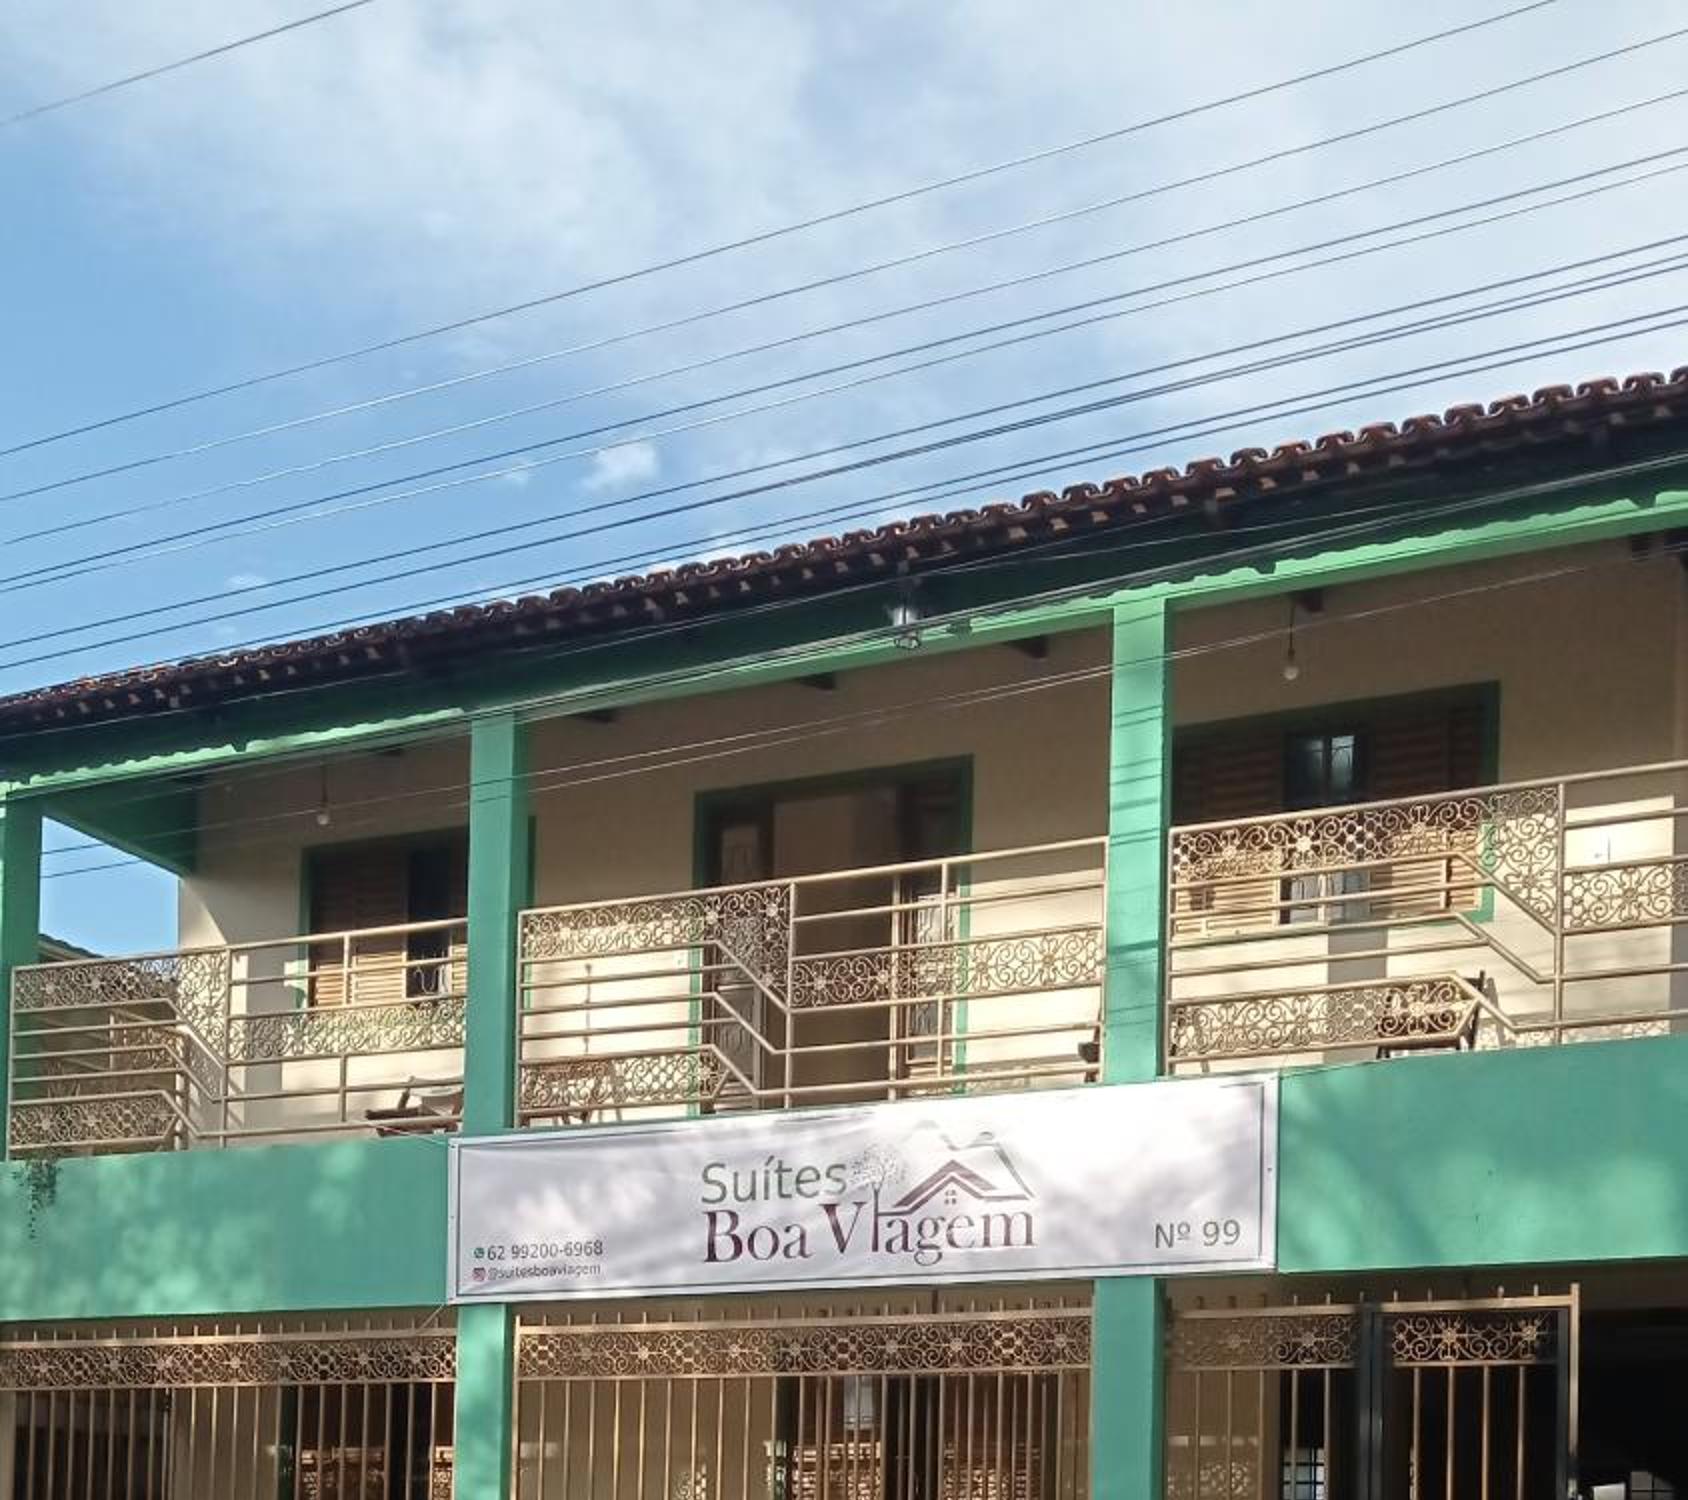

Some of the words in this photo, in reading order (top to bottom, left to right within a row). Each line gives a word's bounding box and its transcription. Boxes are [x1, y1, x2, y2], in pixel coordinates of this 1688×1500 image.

[701, 1155, 847, 1203] Suítes
[487, 1245, 505, 1260] 62
[511, 1239, 603, 1259] 99200-6968
[703, 1209, 812, 1262] Boa
[1203, 1220, 1240, 1246] 99
